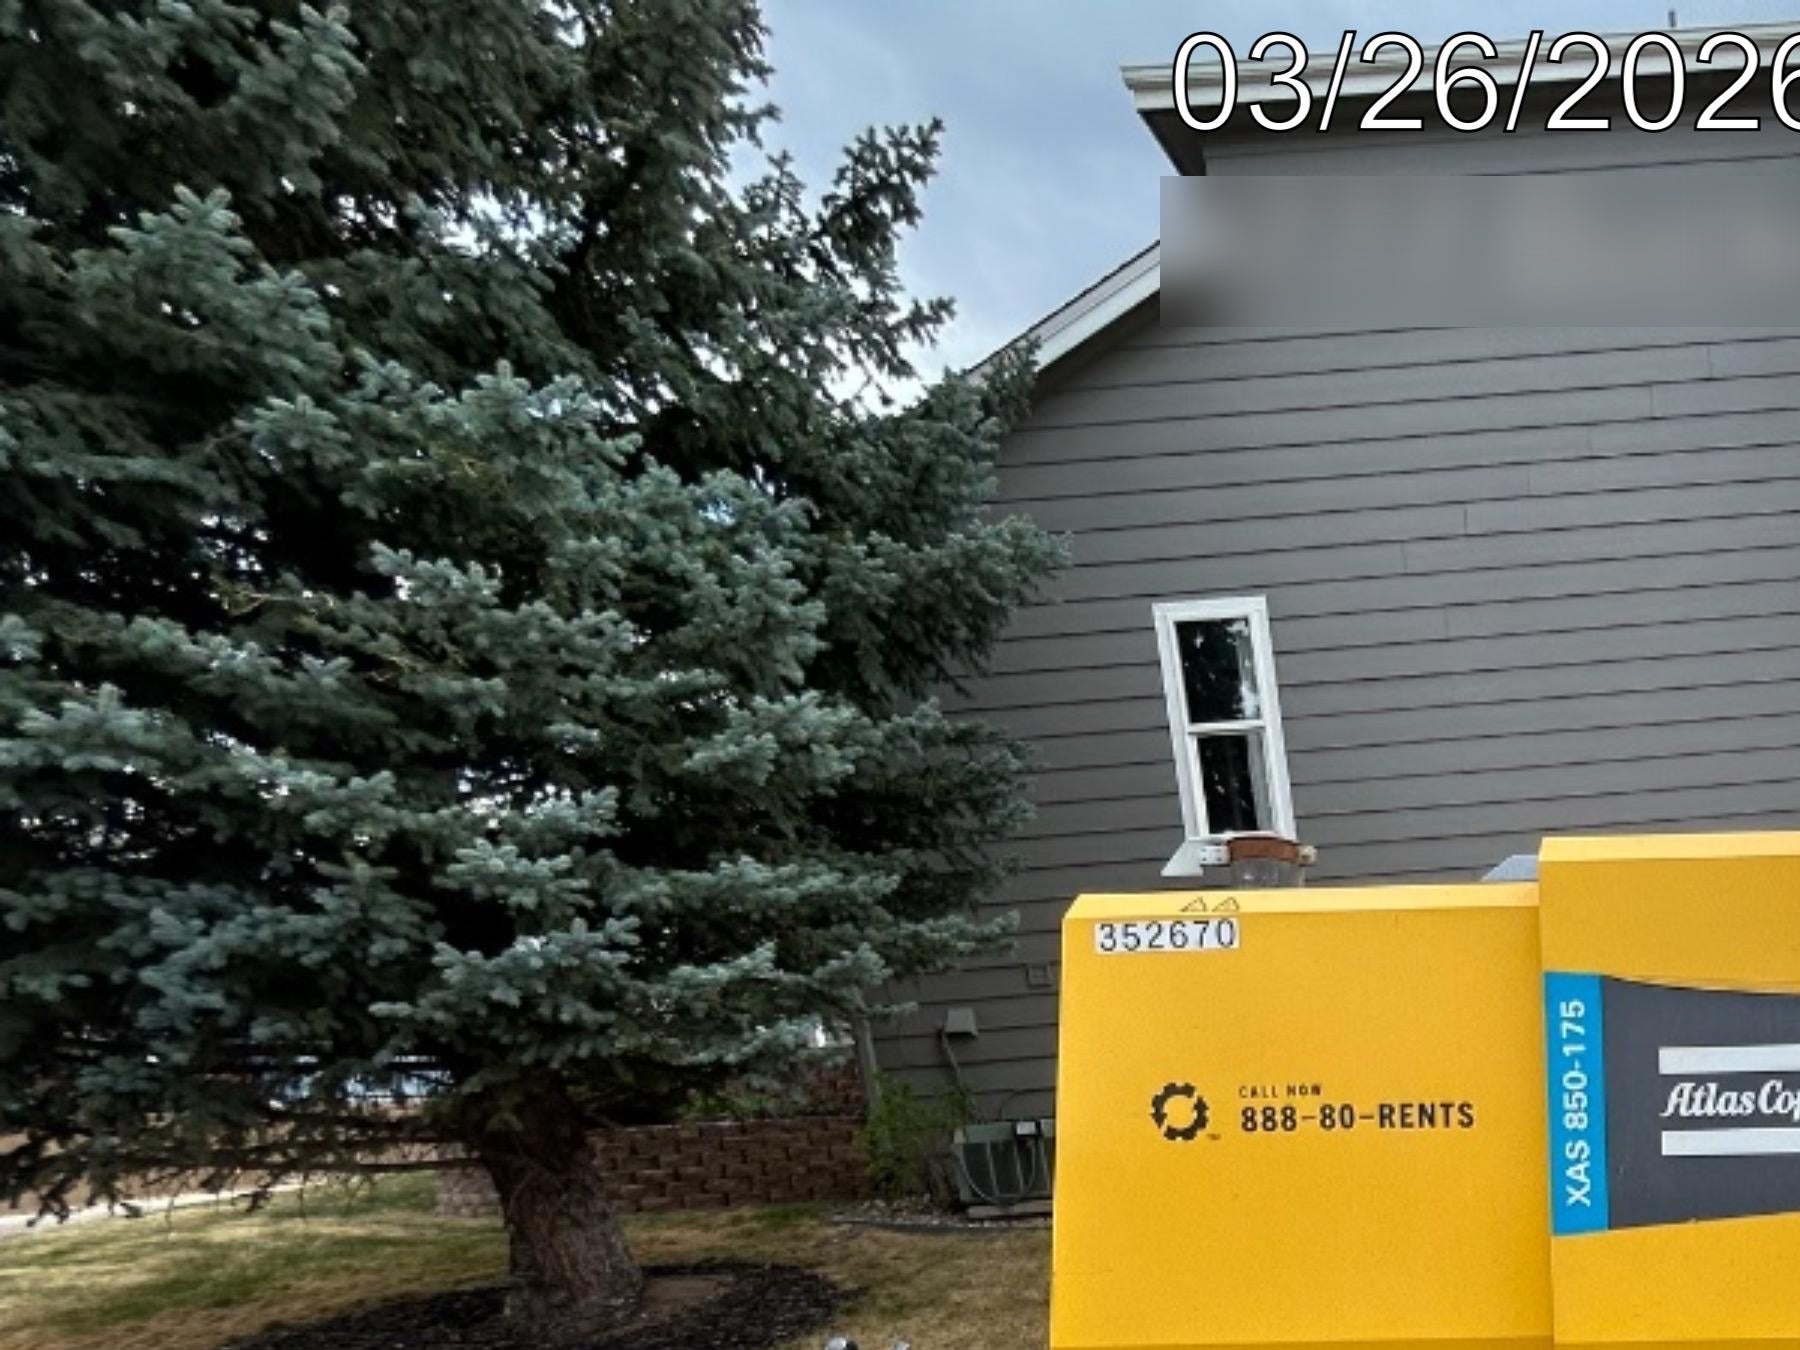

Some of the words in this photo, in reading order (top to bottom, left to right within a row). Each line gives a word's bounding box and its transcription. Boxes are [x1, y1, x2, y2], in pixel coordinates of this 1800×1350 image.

[1099, 918, 1236, 952] 352670
[1560, 999, 1589, 1131] 850-175
[1239, 1085, 1279, 1099] CALL
[1660, 1082, 1756, 1118] Atlas
[1241, 1102, 1475, 1132] 888-80-RENTS
[1566, 1139, 1592, 1208] XAS
